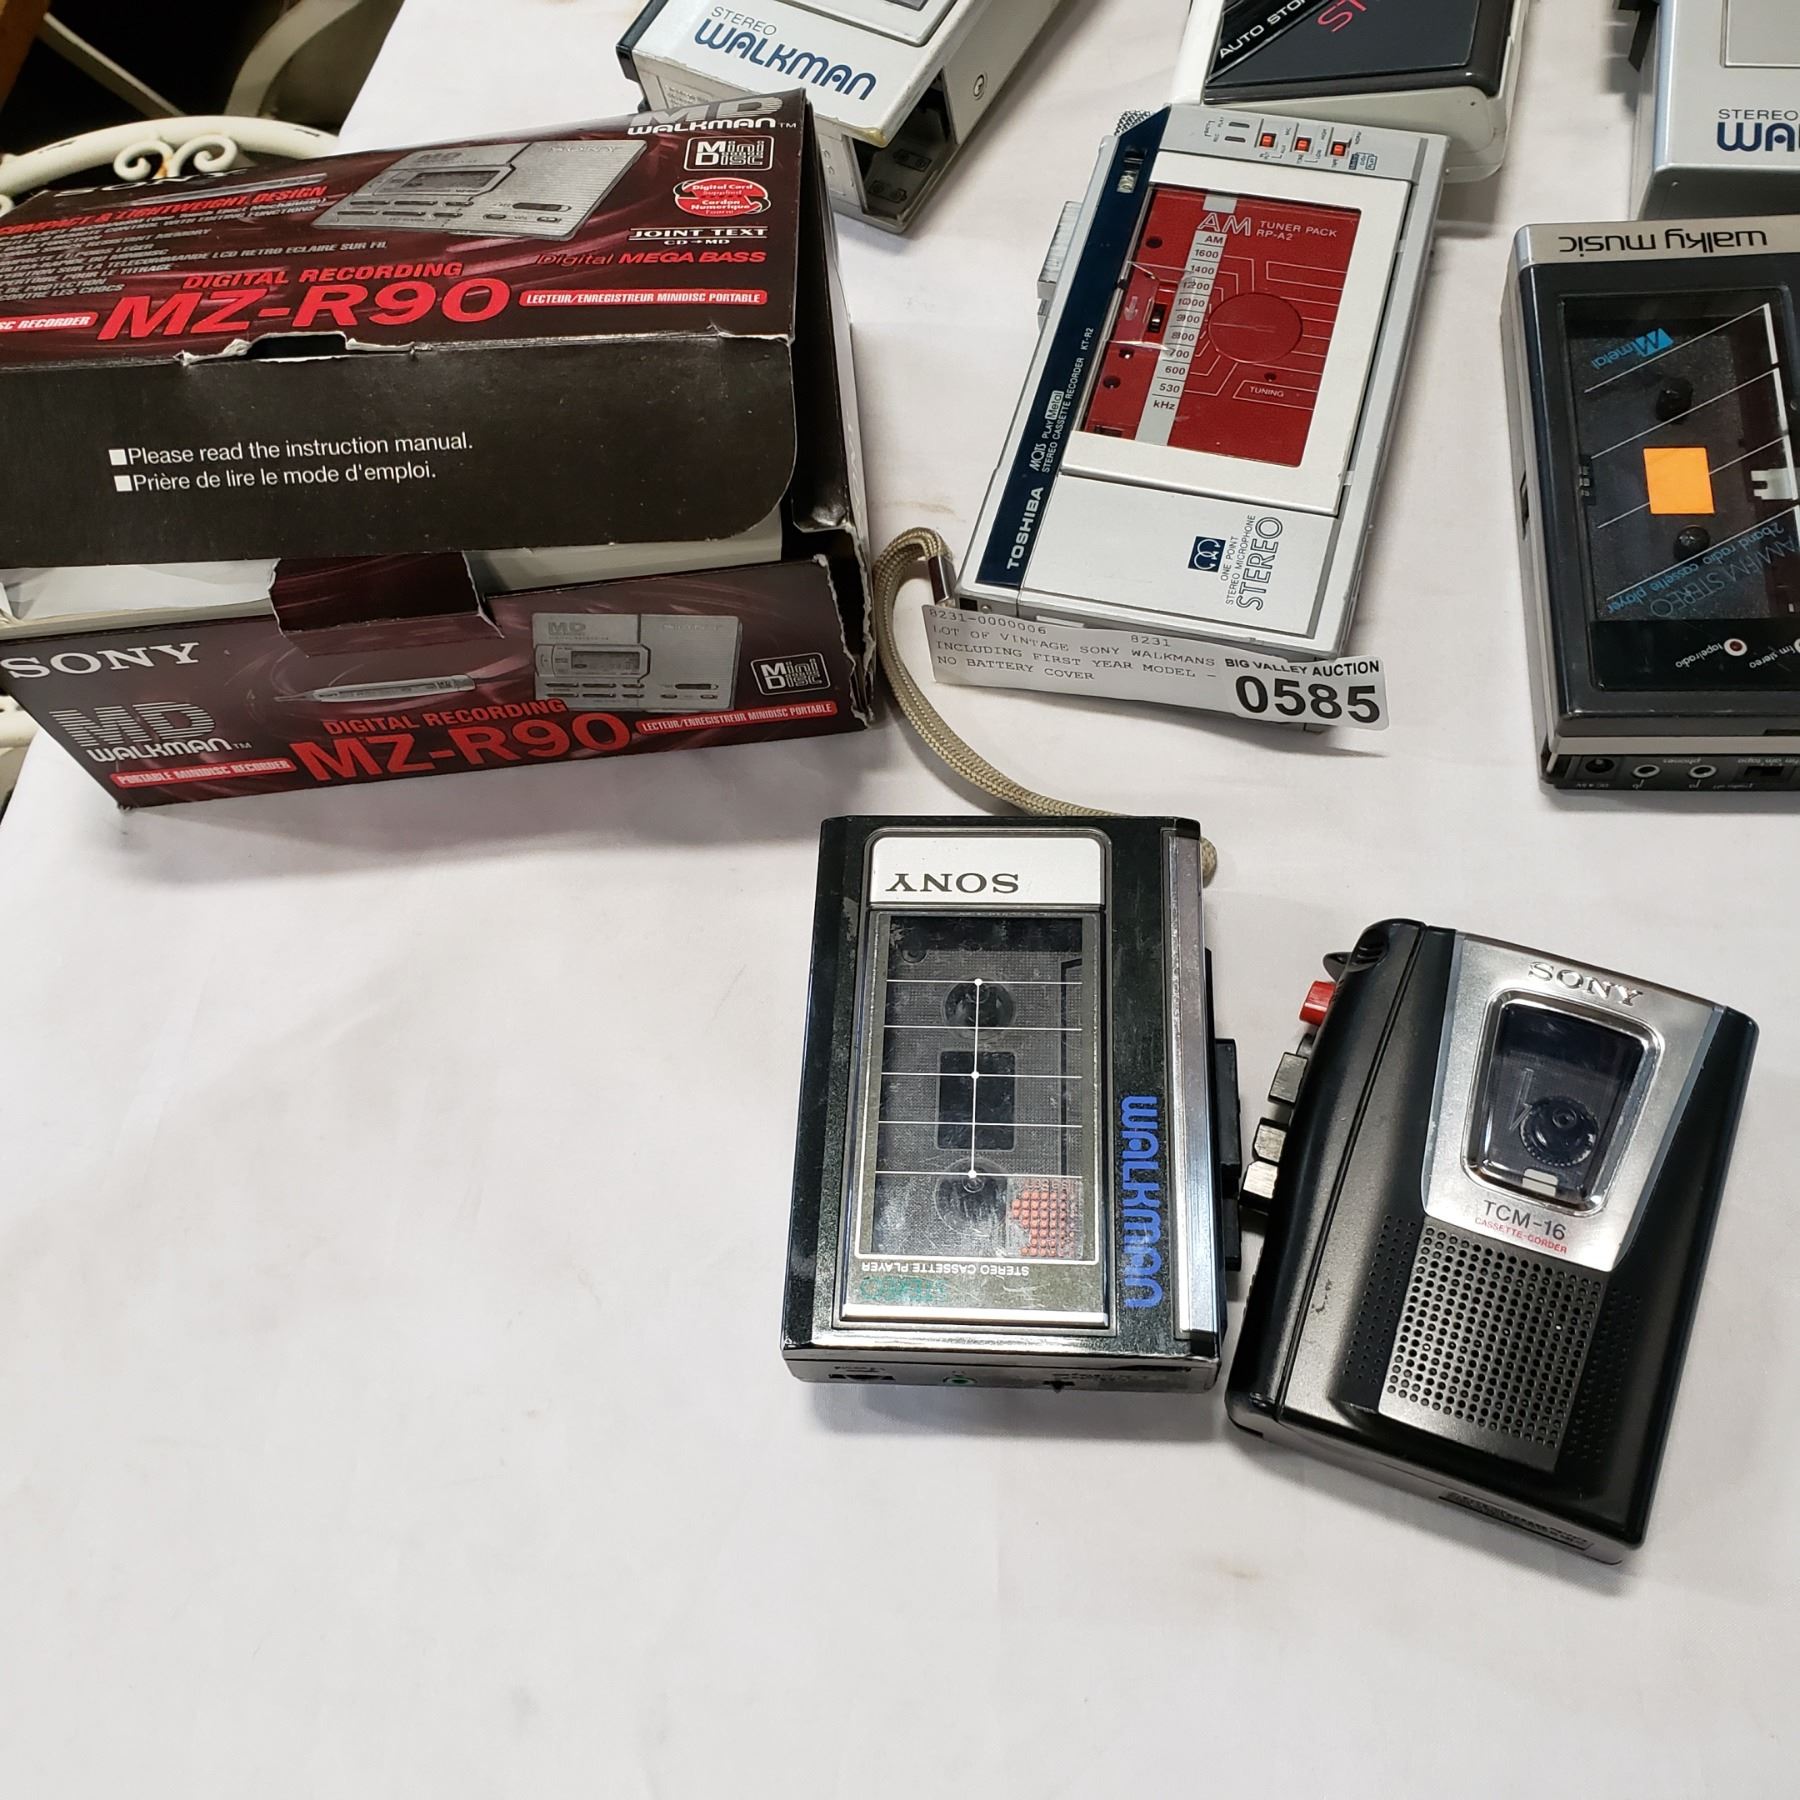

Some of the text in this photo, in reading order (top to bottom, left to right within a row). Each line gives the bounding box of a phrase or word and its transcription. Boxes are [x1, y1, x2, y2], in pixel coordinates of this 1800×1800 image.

[711, 6, 777, 36] STEREO
[1219, 0, 1306, 59] AUTO STO
[694, 18, 877, 101] WALKMAN
[627, 118, 776, 136] WALKMAN
[1718, 109, 1800, 121] STEREO
[1716, 121, 1800, 152] WA
[115, 195, 249, 219] LIGHTWEIGHT
[252, 186, 328, 203] DESIGN
[631, 228, 764, 238] JOINT TEXT
[1197, 212, 1338, 238] AM TUNER PACK
[1256, 229, 1293, 241] RP-A2
[285, 243, 338, 255] ECLAIRE
[340, 241, 368, 251] SUR
[1194, 249, 1219, 259] 1600
[1204, 235, 1224, 245] AM
[1558, 228, 1768, 257] walky music
[537, 251, 768, 267] Digital MEGA BASS
[1190, 265, 1215, 275] 1400
[183, 262, 464, 289] DIGITAL RECORDING
[17, 278, 511, 341] RECORDER MZ-R90
[527, 292, 761, 304] LECTEUR/ENREGISTREUR MINIDISC PORTABLE
[1169, 348, 1190, 359] 700
[1164, 366, 1186, 376] 600
[1159, 383, 1181, 394] 530
[1250, 386, 1284, 397] TUNING
[1042, 441, 1058, 473] STEREO
[1052, 400, 1071, 440] CASSETTE
[1065, 357, 1085, 399] RECORDER
[1046, 391, 1064, 421] Metal
[1153, 400, 1176, 411] kHz
[1042, 420, 1054, 439] PLAY
[128, 432, 473, 466] Please read the instruction manual.
[133, 461, 436, 492] Prière de lire le mode d'emploi.
[1007, 487, 1044, 570] TOSHIBA
[1221, 536, 1239, 581] ONE POINT
[1226, 515, 1256, 605] STEREO MICROPHONE
[1236, 516, 1283, 611] STEREO
[1650, 563, 1699, 591] cassette
[1607, 585, 1647, 614] player
[1651, 571, 1725, 617] STEREO
[933, 624, 1216, 667] LOT OF VINTAGE SONY WALKMANS
[1131, 634, 1170, 648] 8231
[1, 642, 199, 680] SONY
[936, 640, 1195, 678] INCLUDING FIRST YEAR MODEL
[936, 656, 1095, 680] NO BATTERY COVER
[1225, 658, 1380, 678] BIG VALLEY AUCTION
[1749, 652, 1778, 669] stereo
[1235, 675, 1380, 723] 0585
[49, 701, 216, 748] MD
[323, 698, 569, 737] DIGITAL RECORDING
[86, 737, 232, 763] WALKMAN
[118, 771, 172, 785] PORTABLE
[233, 760, 291, 775] RECORDER
[290, 712, 631, 782] MZ-R90
[747, 707, 789, 722] MINIDISC
[789, 702, 832, 718] PORTABLE
[885, 872, 1020, 894] SONY
[1528, 961, 1643, 1007] SONY
[1119, 1095, 1165, 1310] WALKMAN
[1484, 1199, 1567, 1241] TCM-16
[861, 1261, 1030, 1276] STEREO CASSETTE PLAYER
